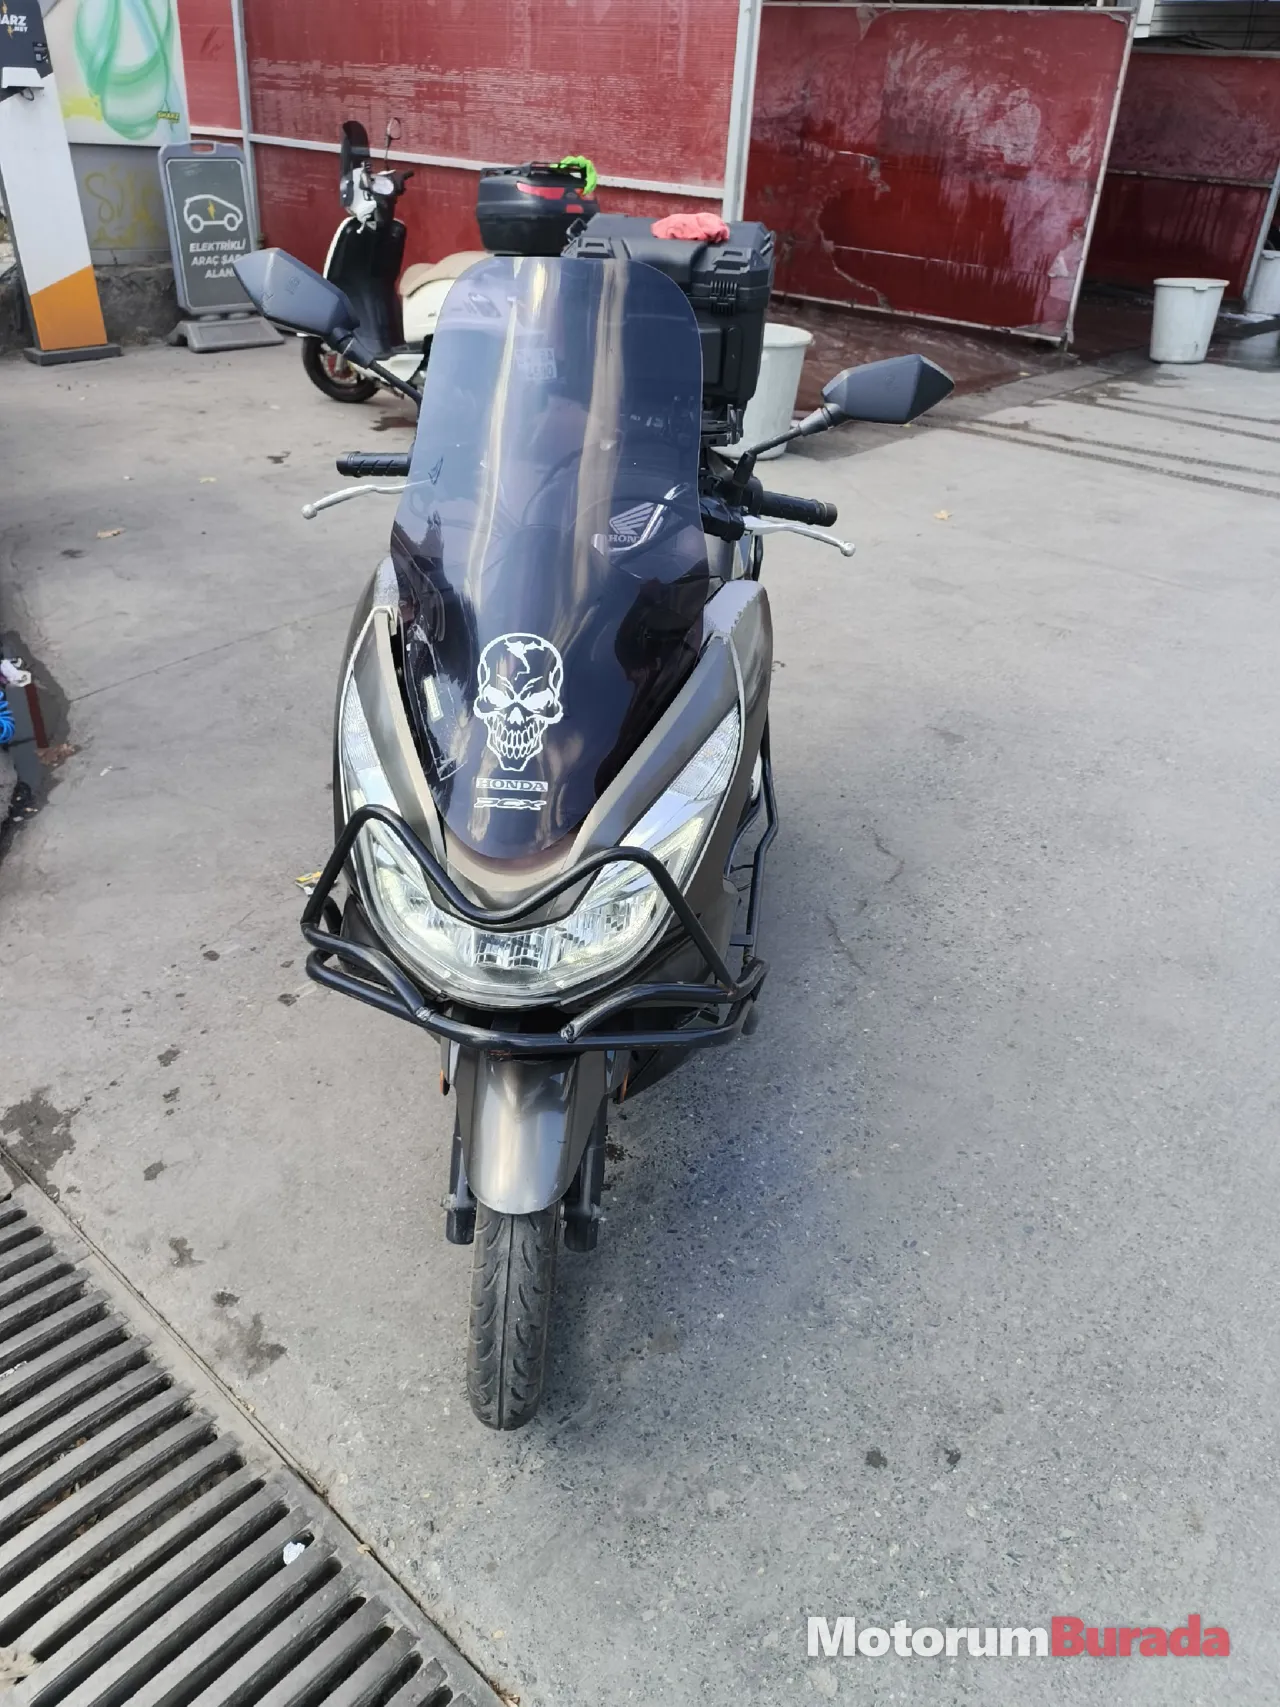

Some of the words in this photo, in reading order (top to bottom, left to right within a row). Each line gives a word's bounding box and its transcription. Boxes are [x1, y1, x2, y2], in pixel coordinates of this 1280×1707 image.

[0, 14, 27, 26] ARZ
[191, 255, 219, 266] ARAÇ
[204, 267, 235, 279] ALAN
[608, 534, 641, 543] HON
[476, 778, 548, 792] HONDA
[474, 797, 547, 811] PCX
